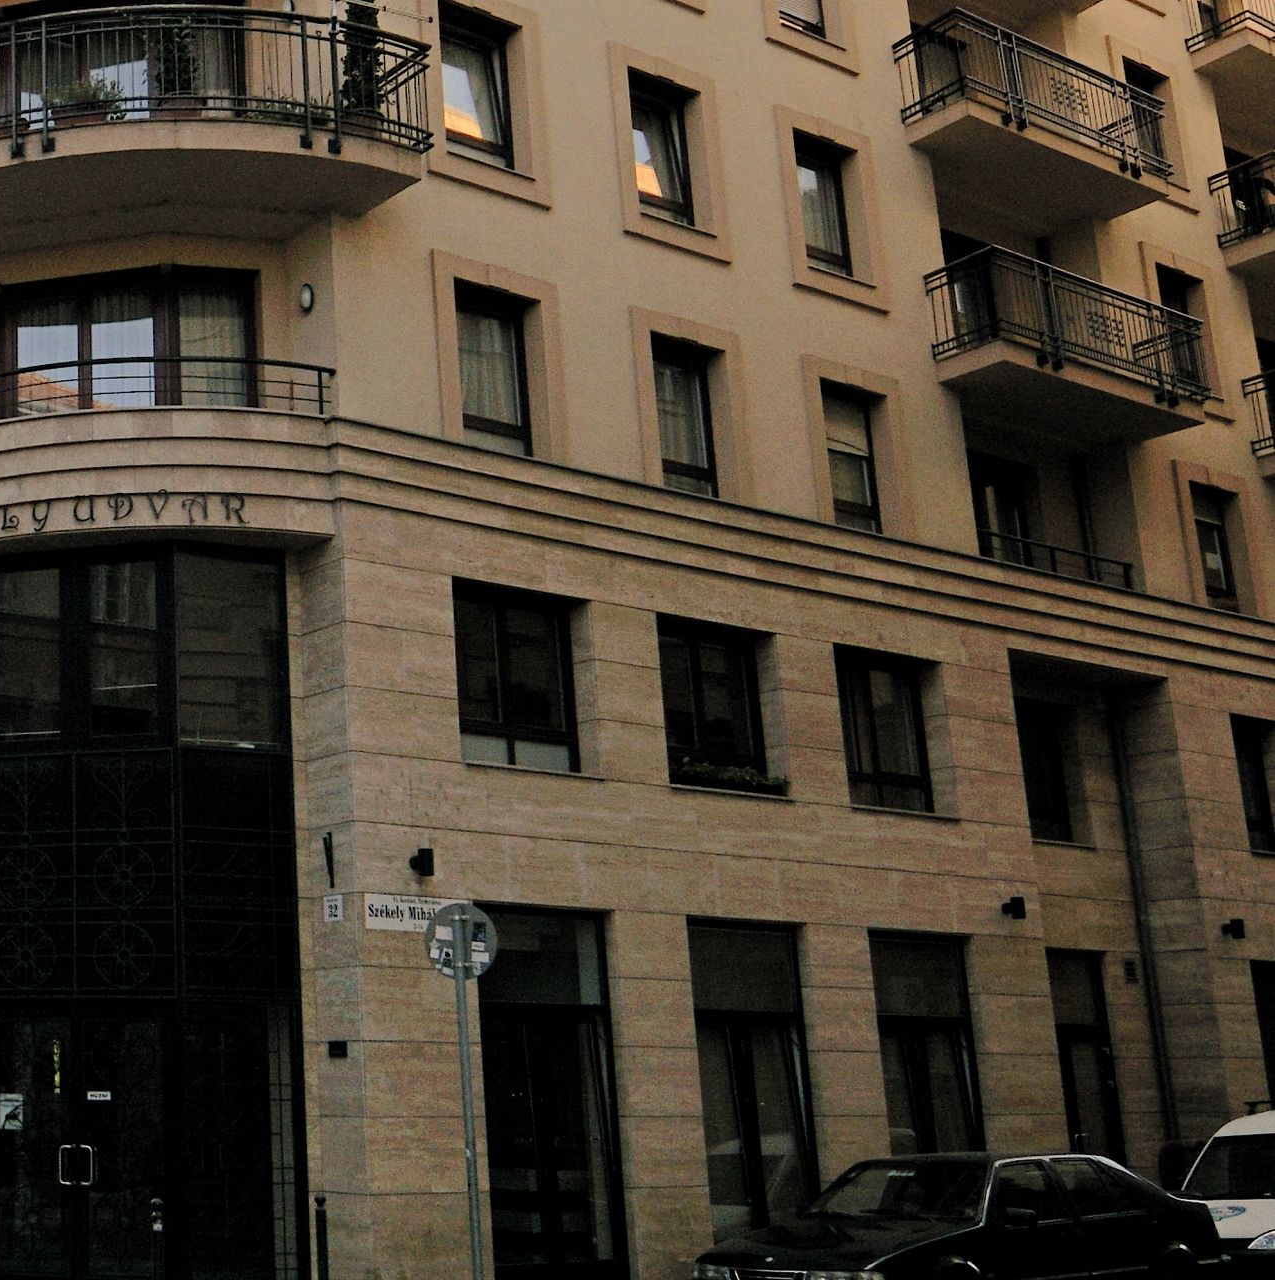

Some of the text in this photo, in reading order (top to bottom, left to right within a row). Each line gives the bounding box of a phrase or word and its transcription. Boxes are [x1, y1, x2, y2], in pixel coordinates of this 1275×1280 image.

[72, 488, 250, 524] UDVAR
[327, 903, 339, 918] 32
[368, 903, 437, 922] Székely Mihál
